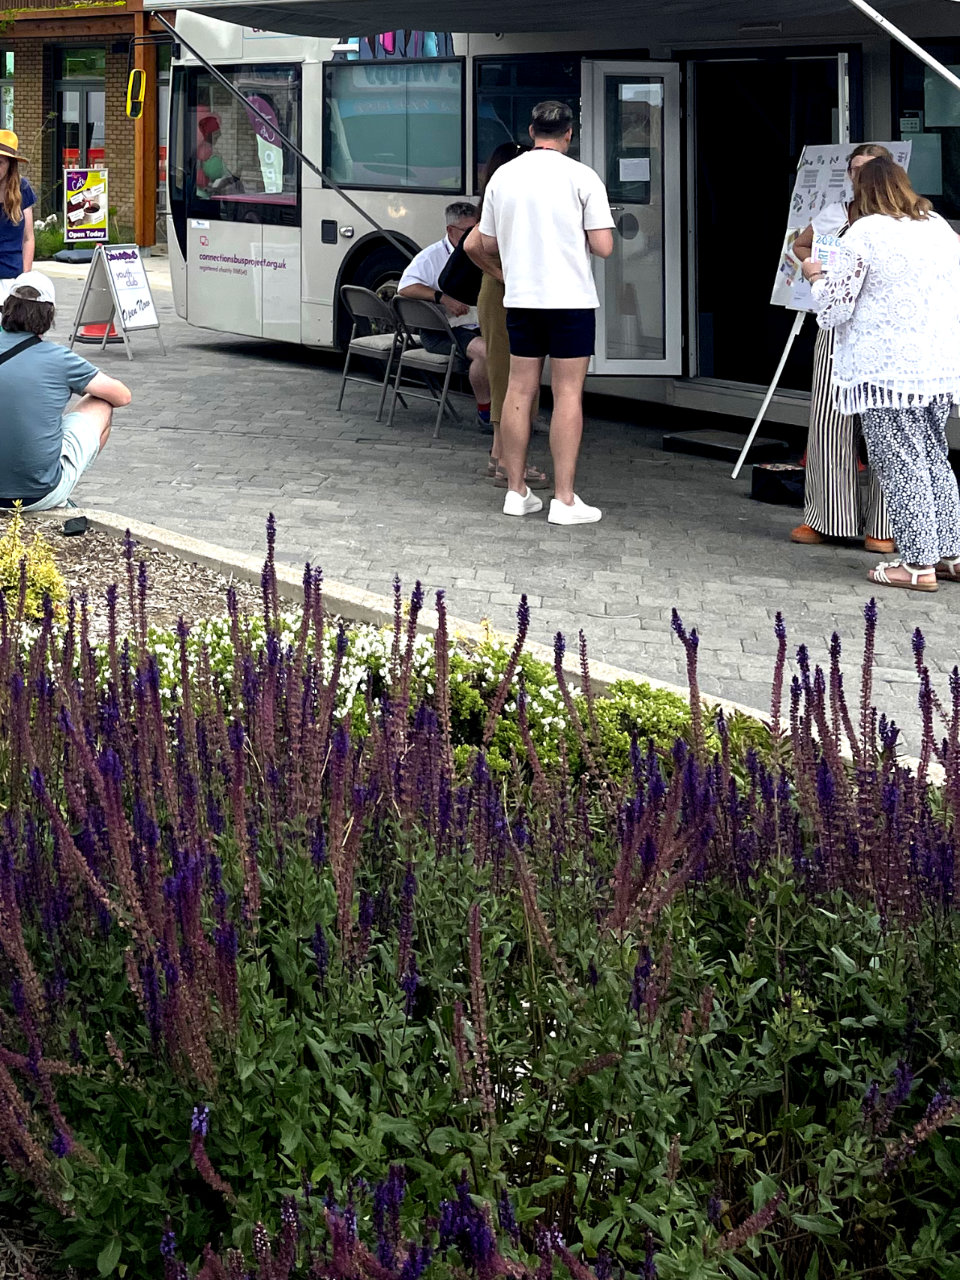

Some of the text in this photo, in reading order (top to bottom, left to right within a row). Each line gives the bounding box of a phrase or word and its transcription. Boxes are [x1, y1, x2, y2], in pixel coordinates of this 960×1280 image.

[86, 230, 105, 238] Today
[199, 253, 287, 270] connectionsbusproject.org.uk
[116, 267, 133, 280] youth
[126, 276, 138, 287] club
